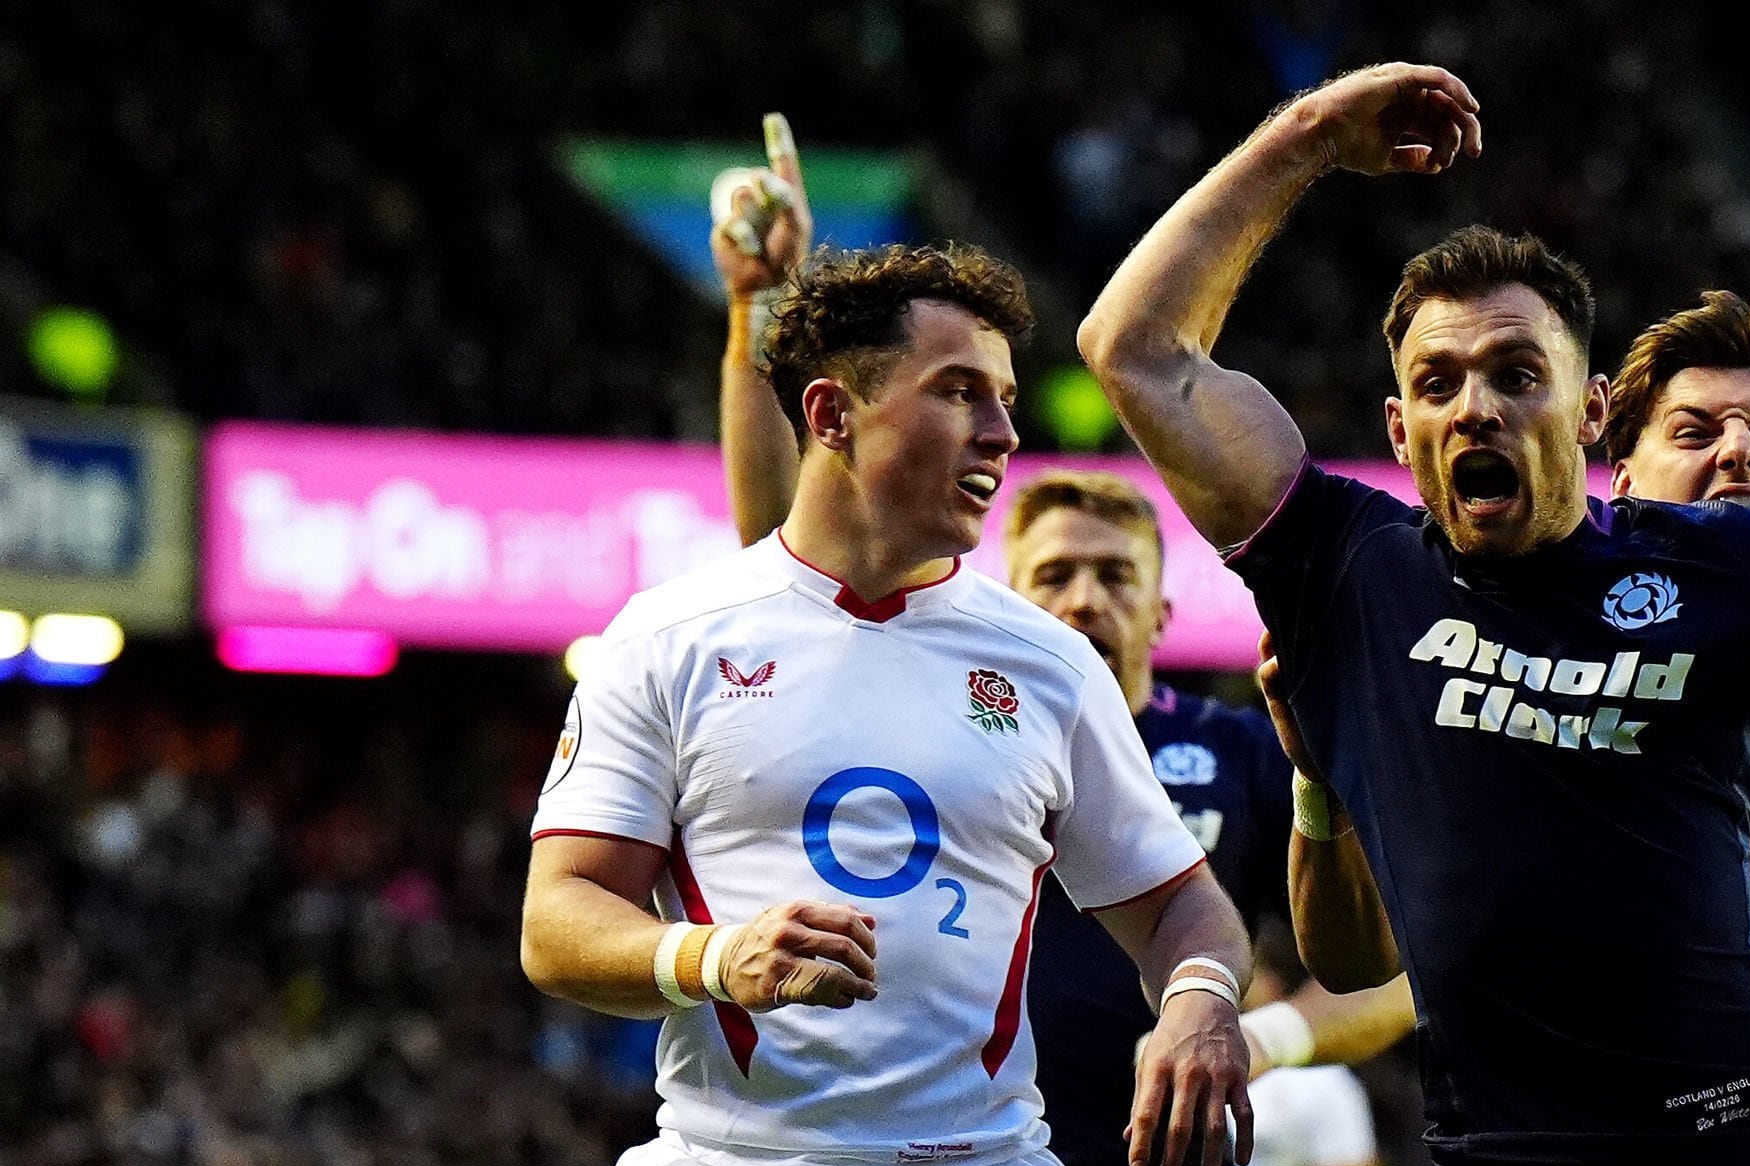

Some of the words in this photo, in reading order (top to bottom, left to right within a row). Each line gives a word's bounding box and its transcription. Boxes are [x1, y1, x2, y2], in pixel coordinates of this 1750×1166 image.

[1409, 618, 1696, 700] Arnold
[1435, 678, 1650, 754] Clark
[1665, 1088, 1716, 1108] SCOTLAND
[1717, 1086, 1724, 1095] V
